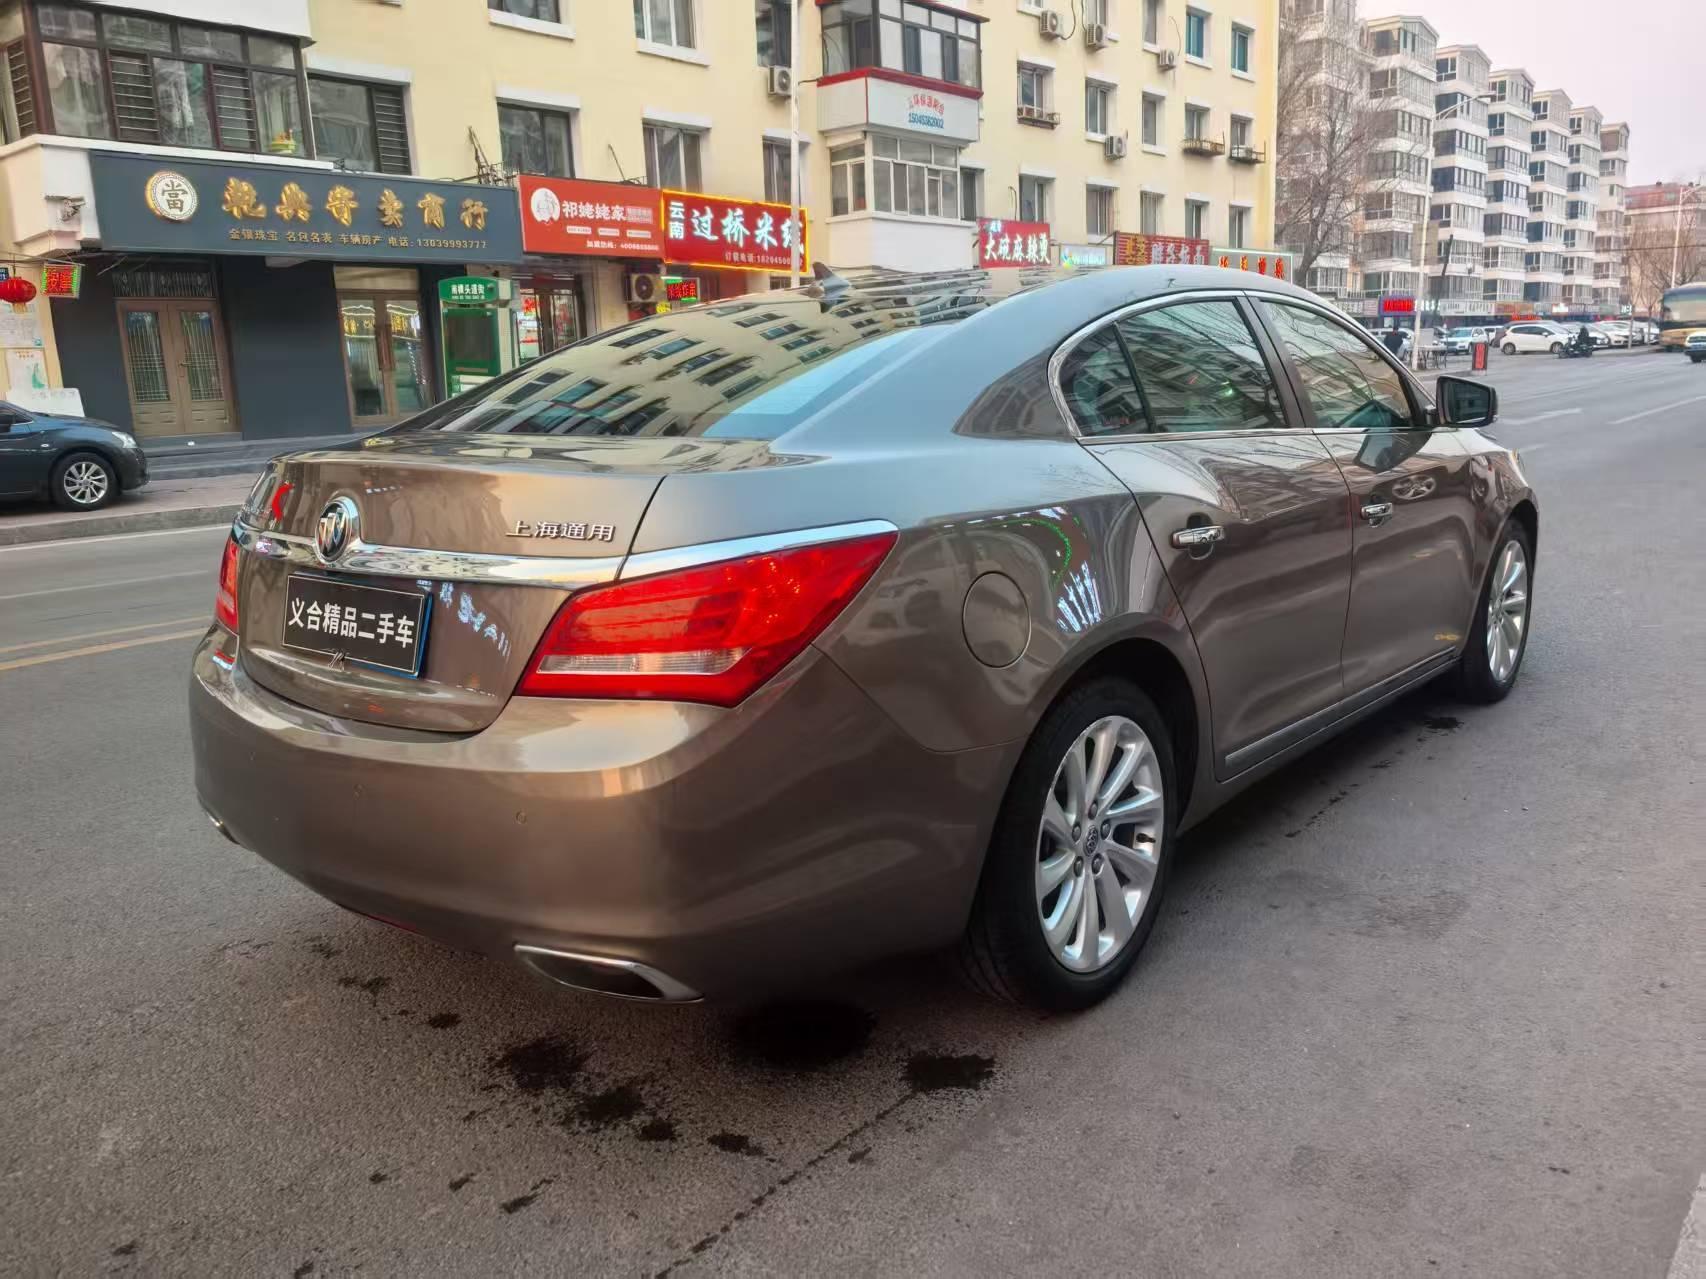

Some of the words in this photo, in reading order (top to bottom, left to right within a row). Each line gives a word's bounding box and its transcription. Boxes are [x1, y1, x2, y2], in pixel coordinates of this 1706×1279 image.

[161, 179, 189, 213] 當
[669, 201, 684, 239] 云南
[286, 231, 332, 244] 名包名表
[506, 520, 616, 542] 上海通用
[288, 597, 415, 648] 义合精品二手车
